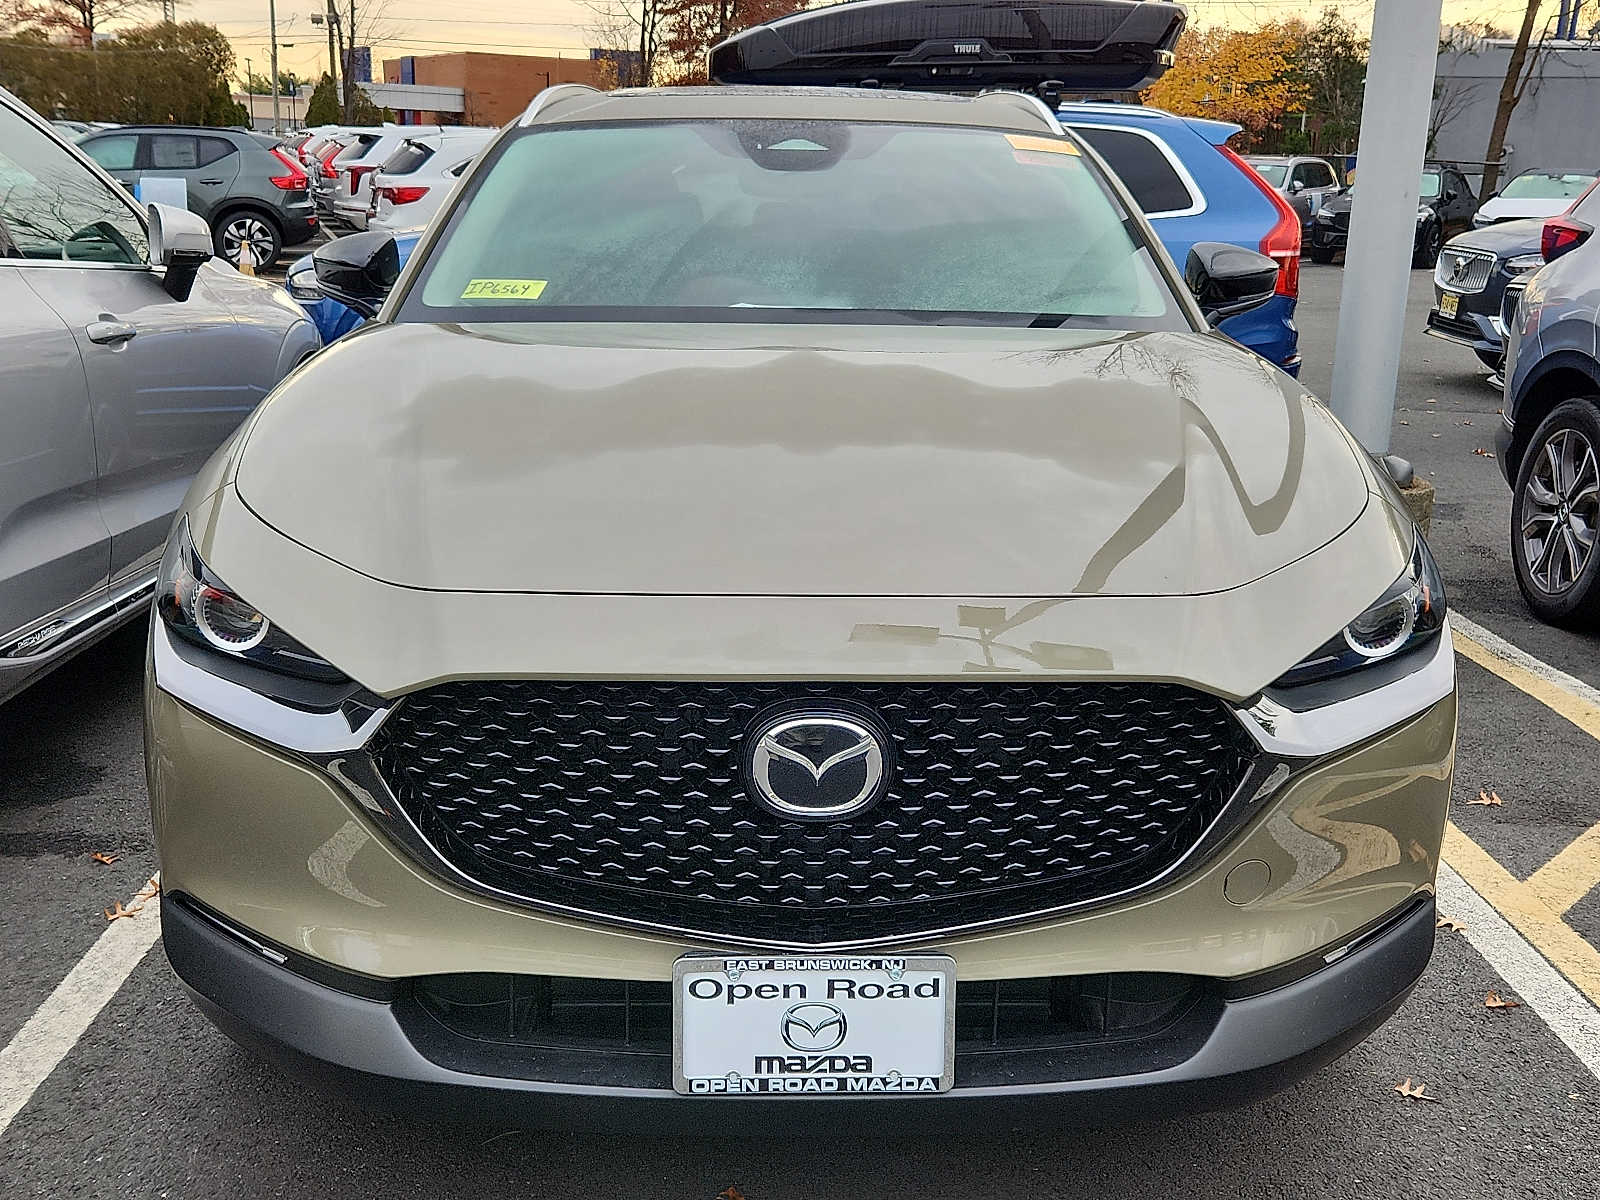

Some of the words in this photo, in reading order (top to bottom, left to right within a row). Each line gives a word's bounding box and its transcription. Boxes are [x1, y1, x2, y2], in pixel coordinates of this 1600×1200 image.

[953, 44, 981, 53] THULE
[726, 960, 769, 971] EAST
[881, 960, 905, 971] NJ
[688, 978, 807, 1005] Open
[827, 977, 941, 1000] Road
[691, 1078, 760, 1093] OPEN
[768, 1078, 839, 1092] ROAD
[846, 1077, 937, 1092] MAZDA
